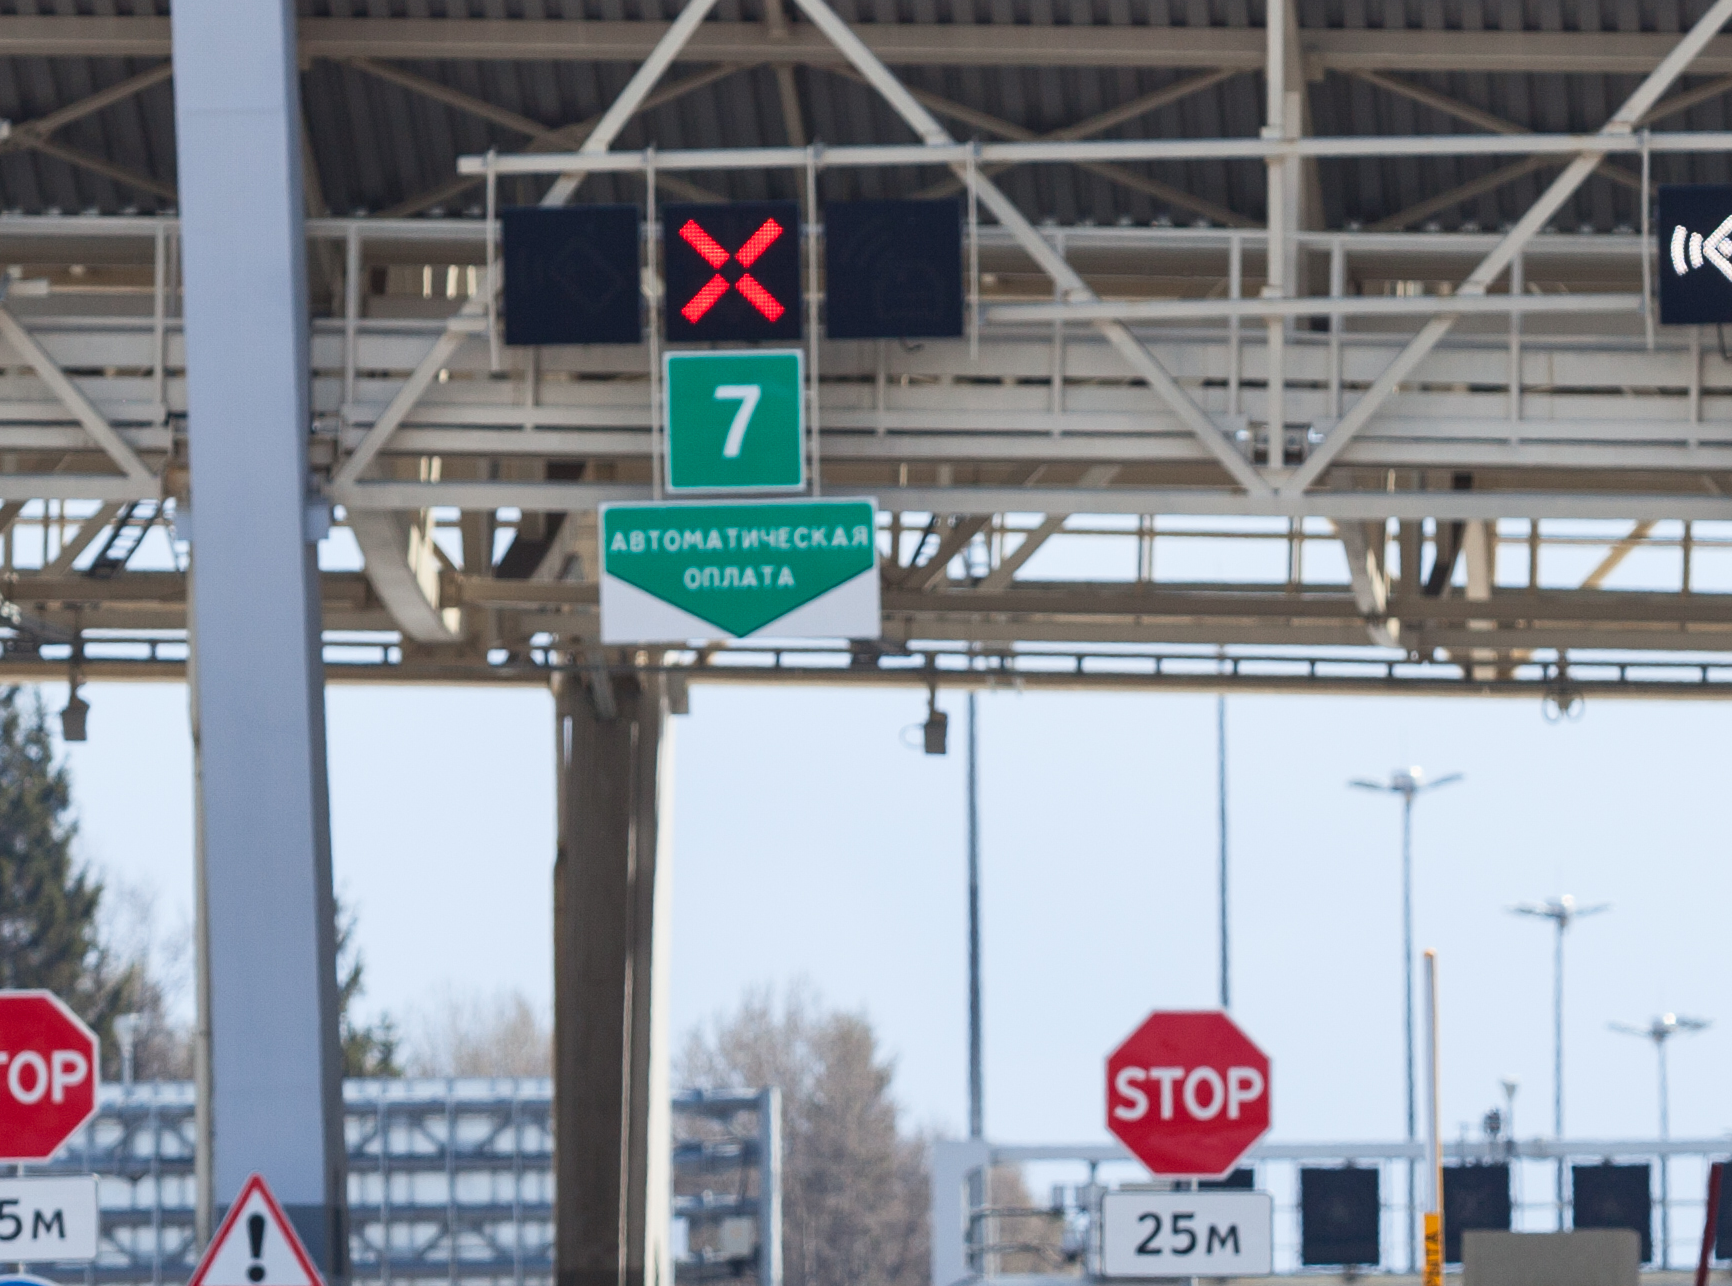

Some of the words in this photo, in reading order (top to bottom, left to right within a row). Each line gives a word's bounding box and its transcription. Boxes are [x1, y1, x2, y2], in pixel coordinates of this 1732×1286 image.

[714, 385, 761, 458] 7
[610, 525, 869, 553] АВТОМАТИЧЕСКАЯ
[683, 564, 795, 590] ОПЛАТА
[1113, 1066, 1265, 1120] STOP
